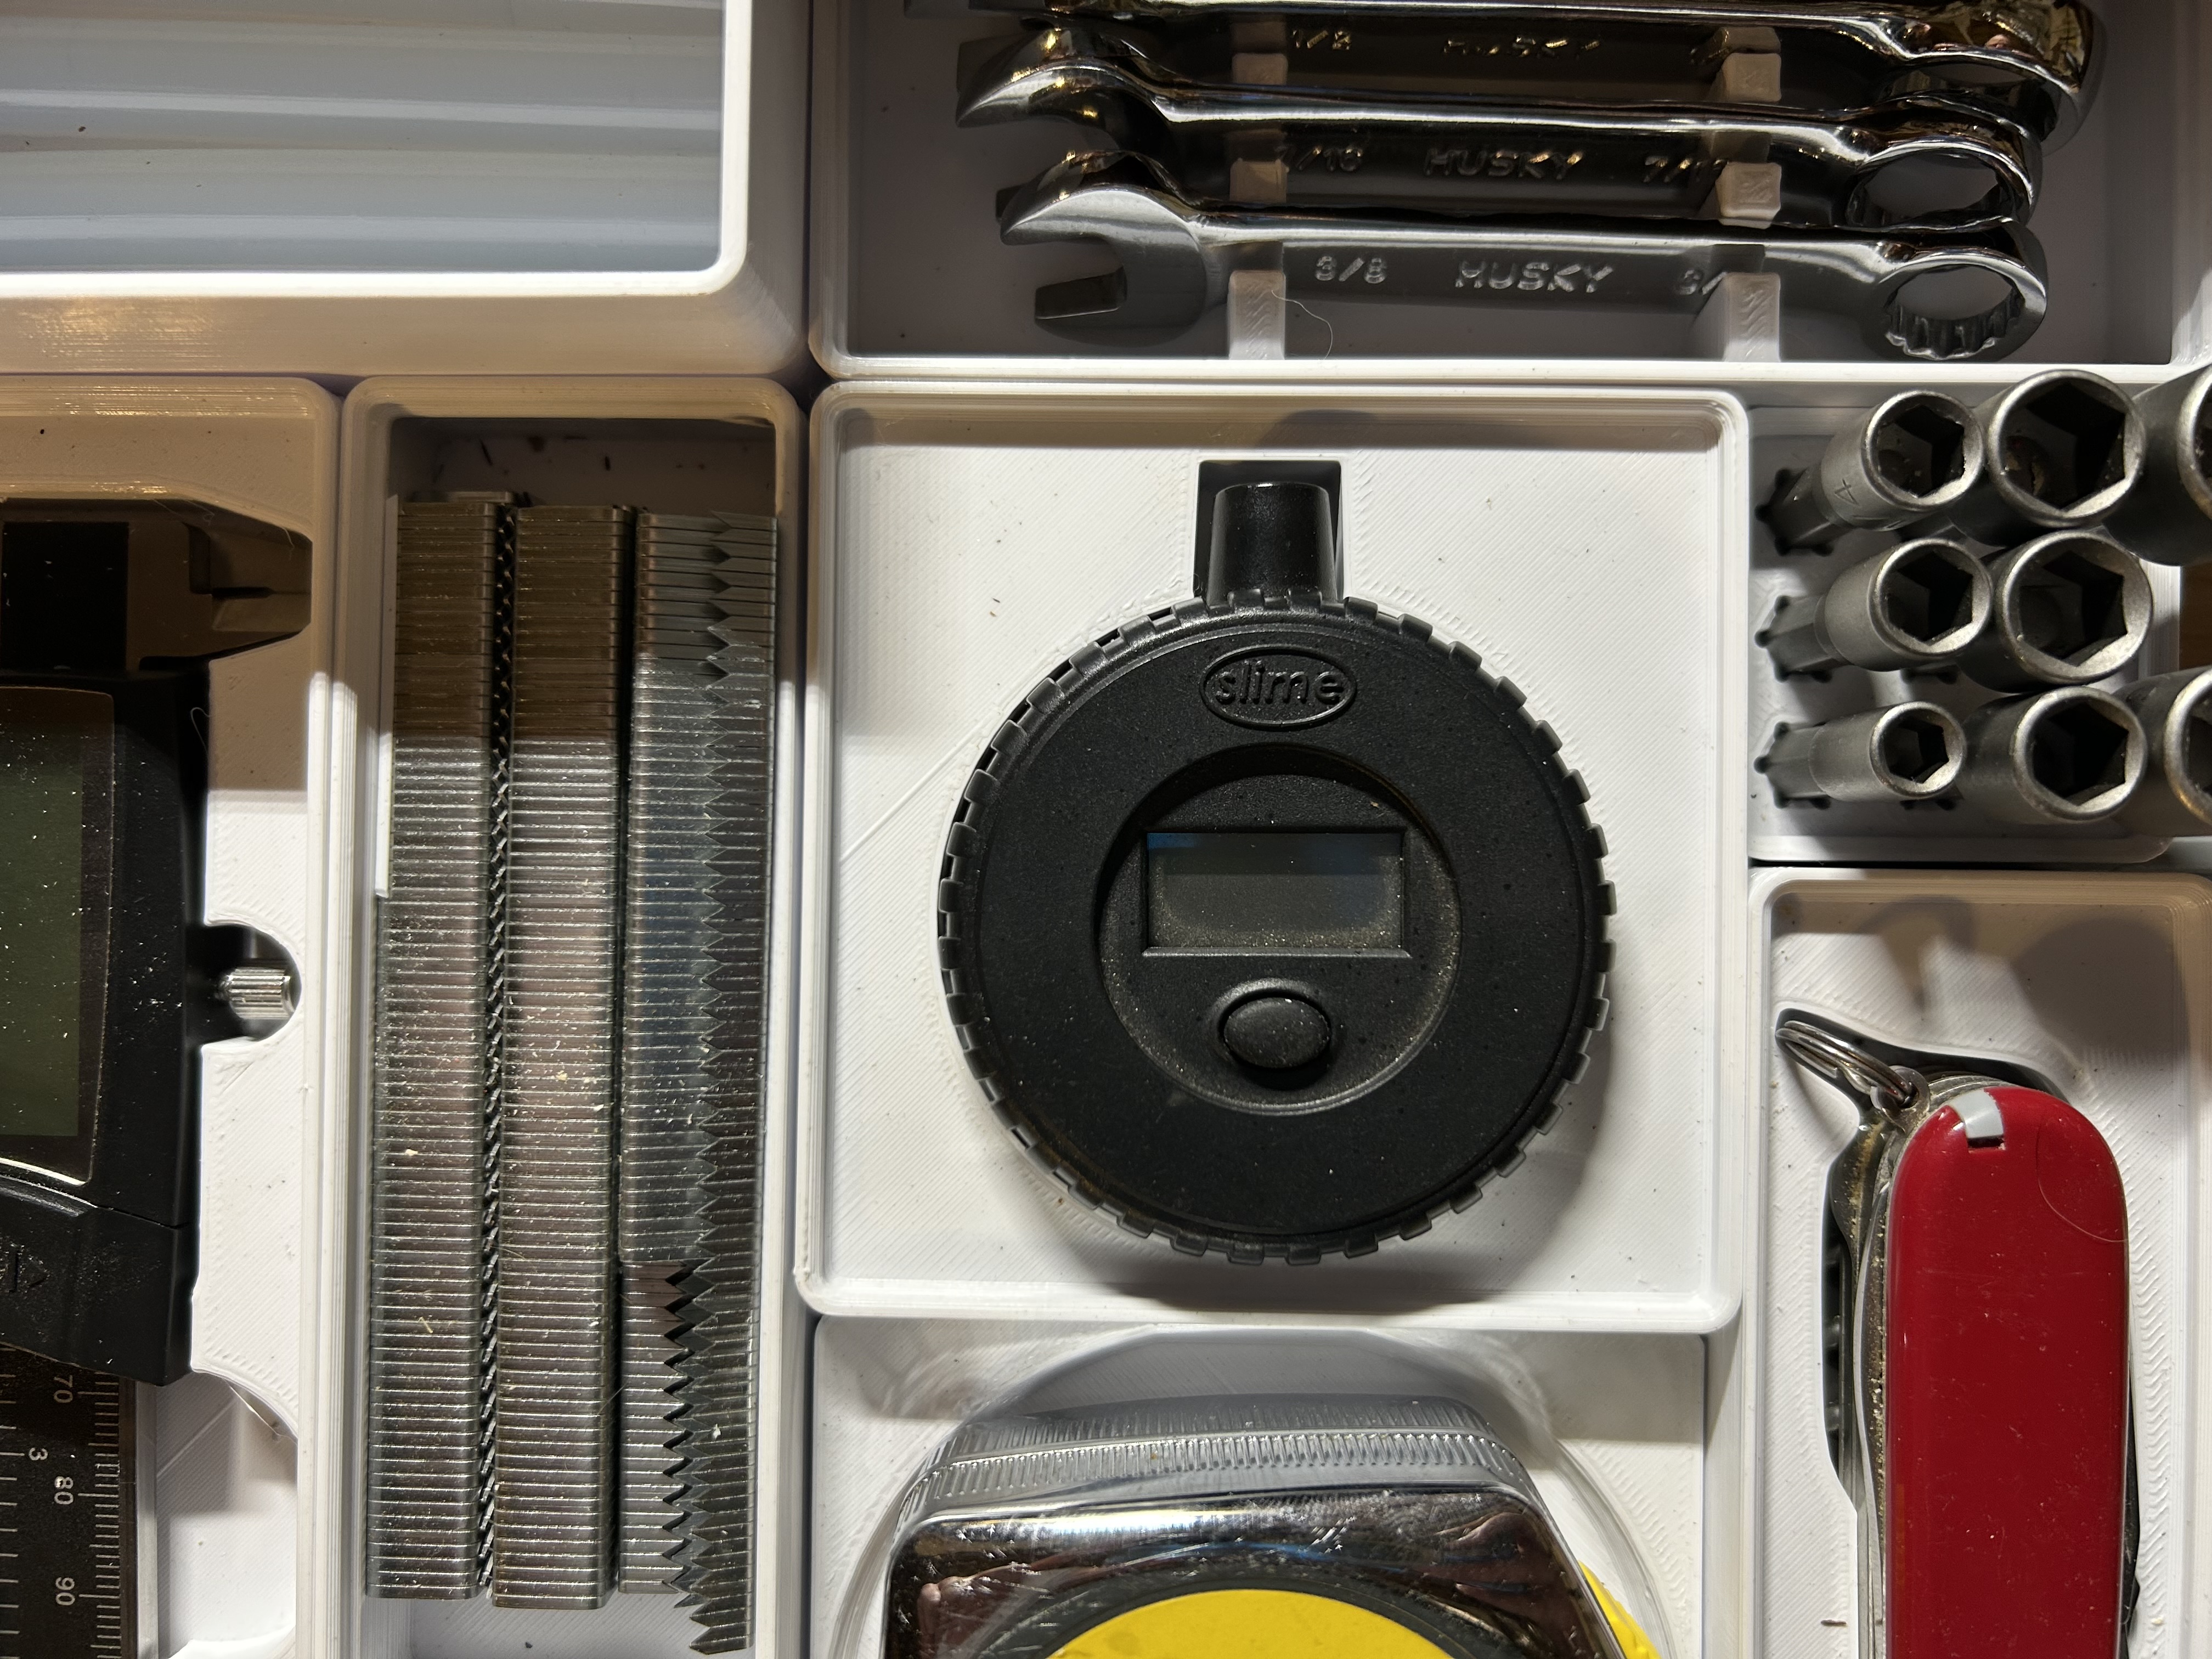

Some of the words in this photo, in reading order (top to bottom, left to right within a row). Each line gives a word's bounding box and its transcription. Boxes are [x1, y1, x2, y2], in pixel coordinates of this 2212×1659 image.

[1425, 149, 1584, 180] HUSKY
[1316, 255, 1387, 284] 3/8
[1454, 261, 1615, 293] HUSKY
[1215, 659, 1345, 705] slime
[53, 1374, 74, 1404] 70
[28, 1447, 49, 1462] 3
[54, 1476, 74, 1505] 80
[55, 1576, 76, 1606] 90
